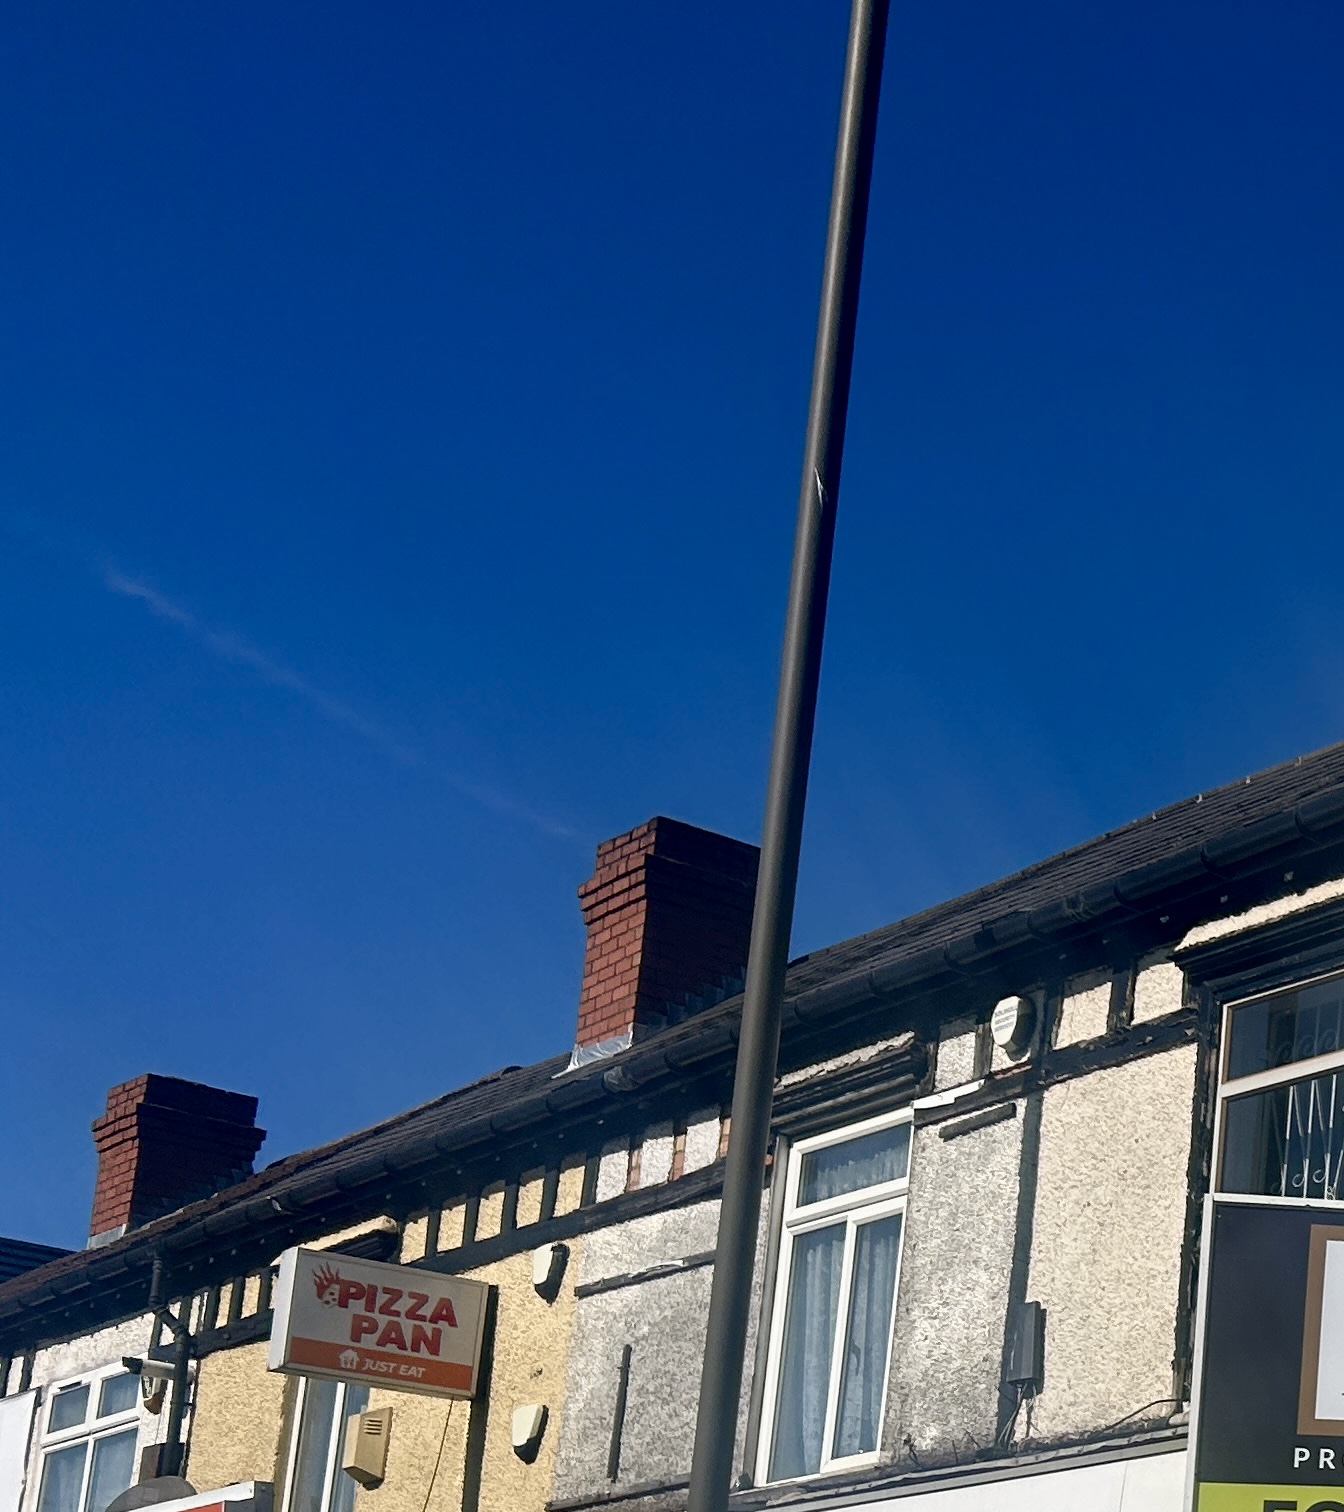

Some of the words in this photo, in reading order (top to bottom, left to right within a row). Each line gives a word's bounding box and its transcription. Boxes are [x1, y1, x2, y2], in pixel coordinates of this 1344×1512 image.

[337, 1278, 459, 1328] PIZZA
[351, 1313, 443, 1357] PAN
[362, 1357, 398, 1373] JUST
[400, 1363, 427, 1378] EAT
